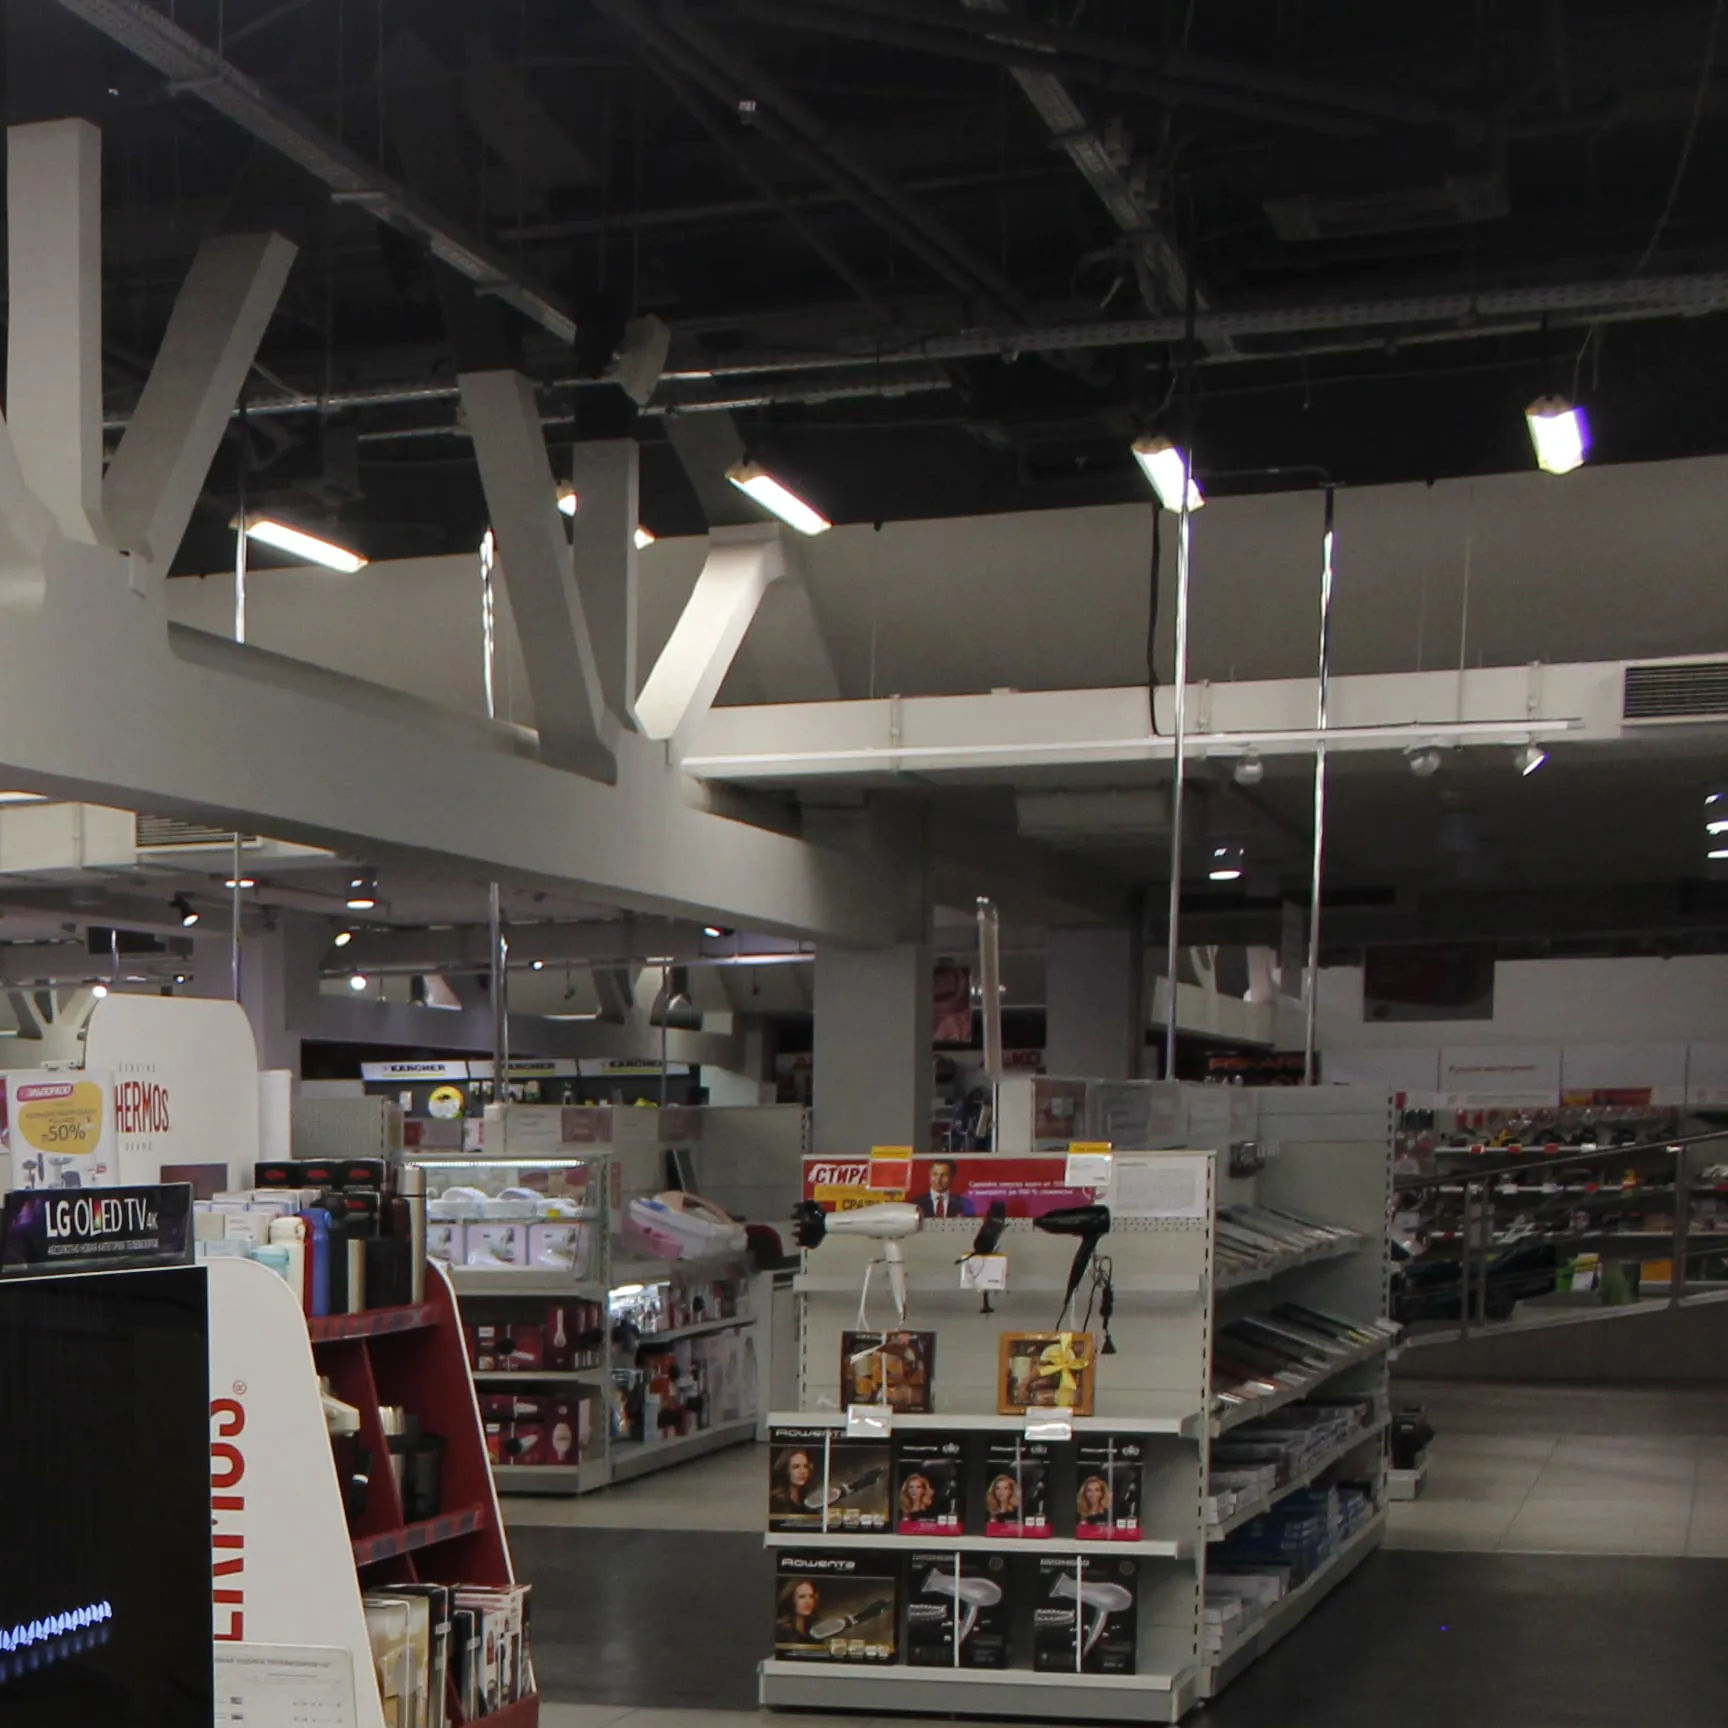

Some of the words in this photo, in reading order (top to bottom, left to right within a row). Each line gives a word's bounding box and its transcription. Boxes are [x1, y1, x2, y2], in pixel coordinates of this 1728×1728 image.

[115, 1081, 169, 1133] HERMOS
[816, 1167, 868, 1184] СТИРА
[45, 1200, 71, 1238] LG
[74, 1196, 122, 1237] OLED
[125, 1198, 147, 1231] TV
